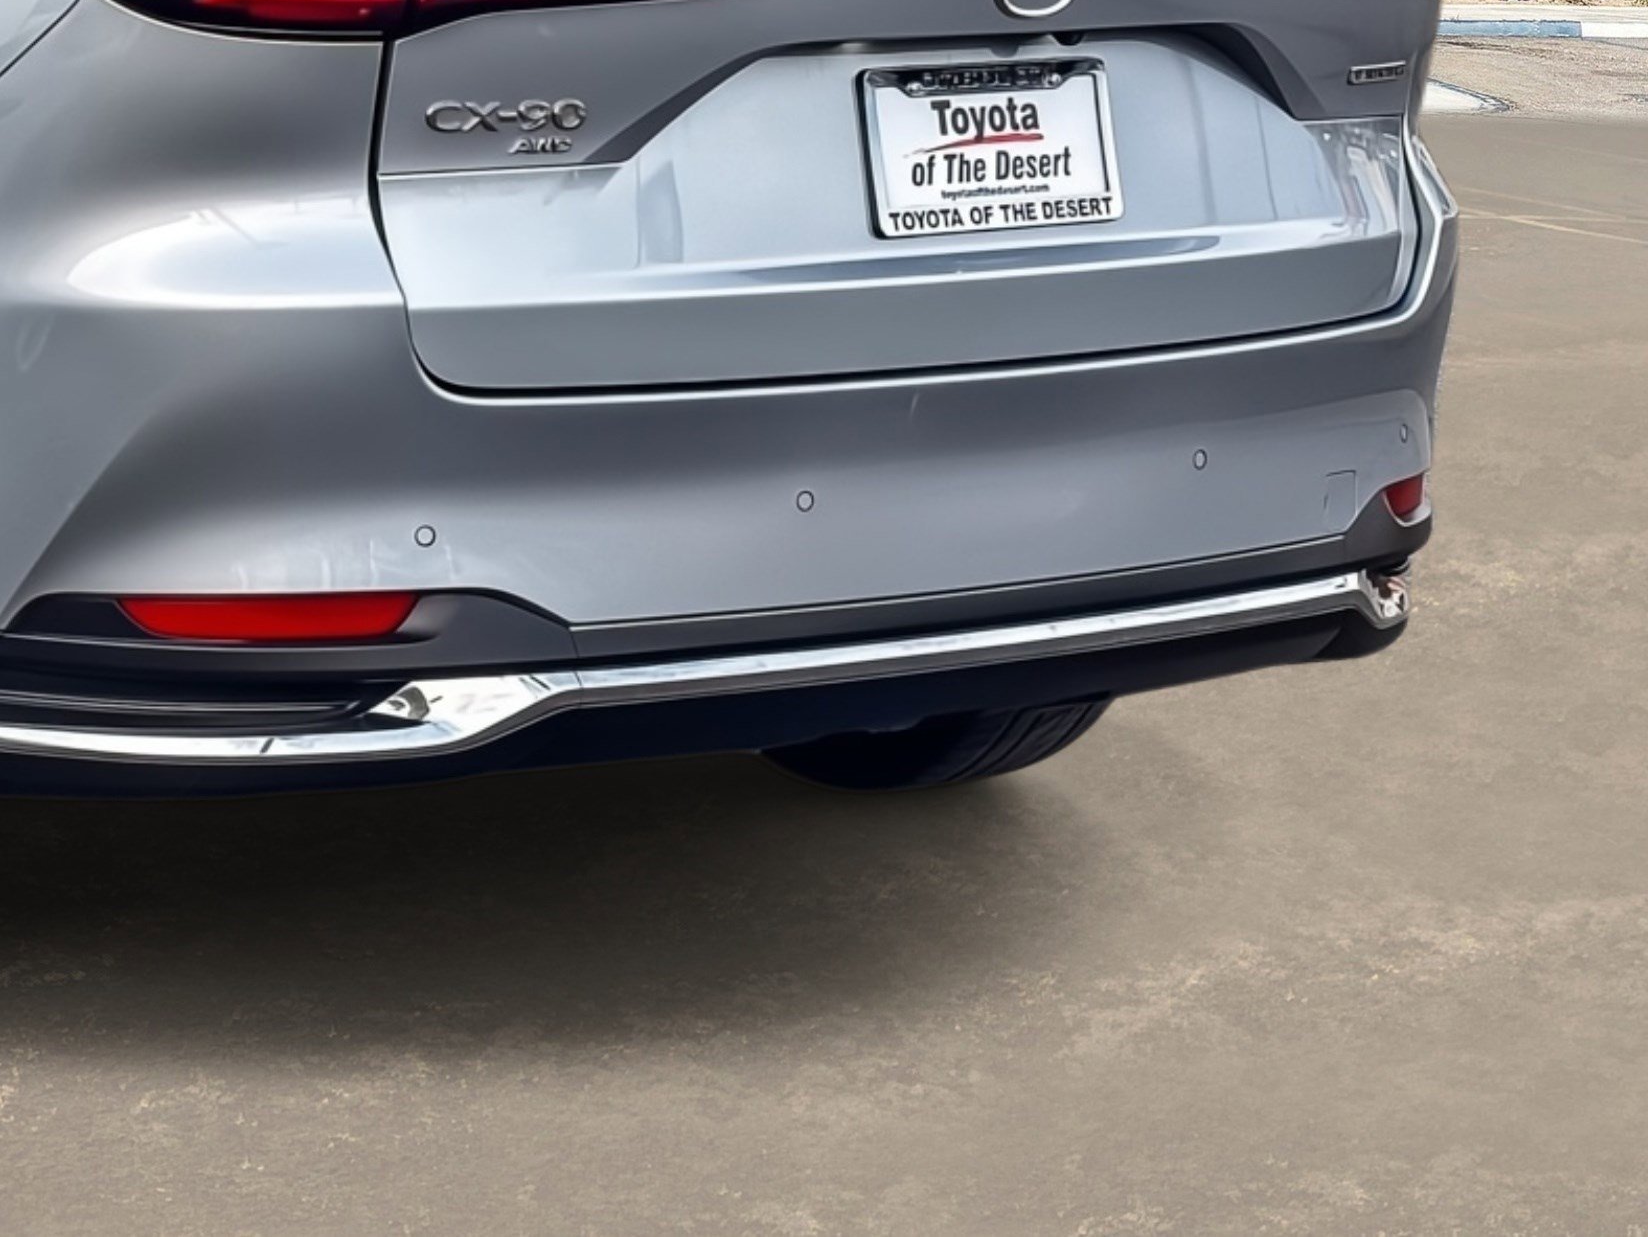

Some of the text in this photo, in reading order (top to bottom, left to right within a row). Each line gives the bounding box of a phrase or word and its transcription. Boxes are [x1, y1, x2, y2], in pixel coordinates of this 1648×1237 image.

[425, 98, 587, 132] CX-90
[930, 97, 1040, 142] Toyota
[911, 146, 1072, 187] of The Desert
[888, 196, 1113, 232] TOYOTA OF THE DESERT
